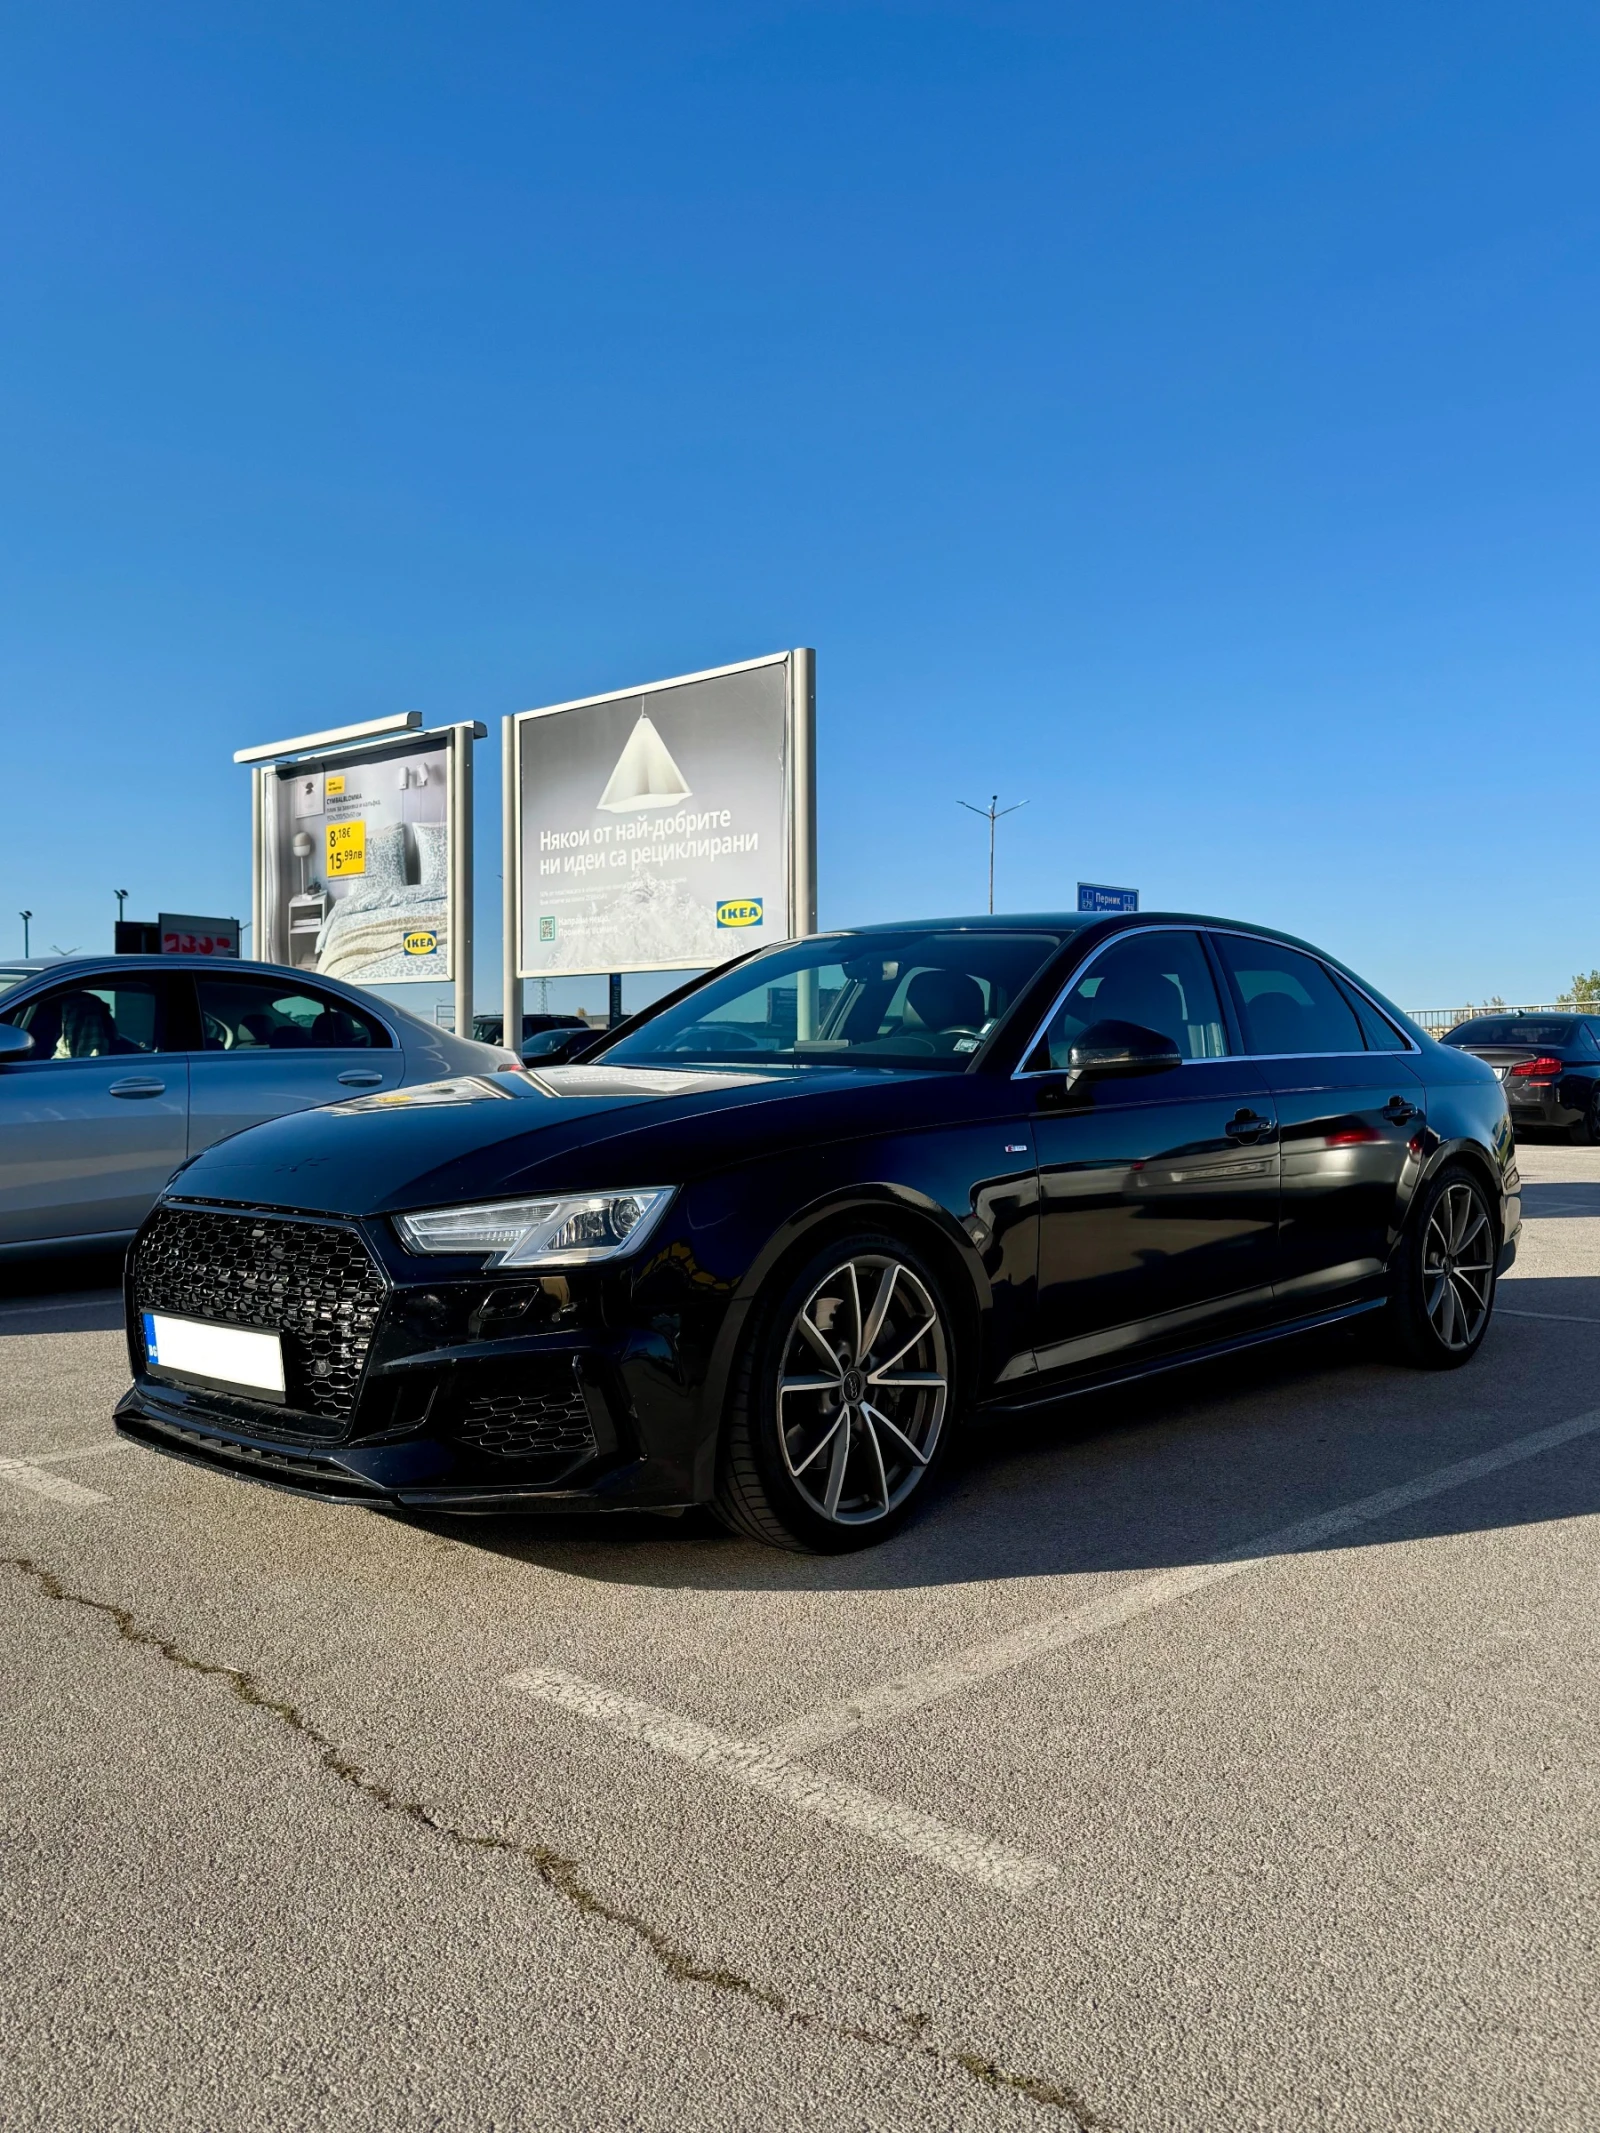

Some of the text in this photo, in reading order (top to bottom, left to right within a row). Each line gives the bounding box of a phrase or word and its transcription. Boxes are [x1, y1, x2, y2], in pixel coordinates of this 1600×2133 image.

[540, 809, 731, 851] Някои от най-добрите
[540, 833, 758, 876] ни идеи са рециклирани
[1095, 892, 1121, 906] Перник
[721, 906, 759, 919] IKEA
[407, 938, 434, 948] IKEA
[613, 985, 621, 1018] Parking
[148, 1344, 158, 1357] BG
